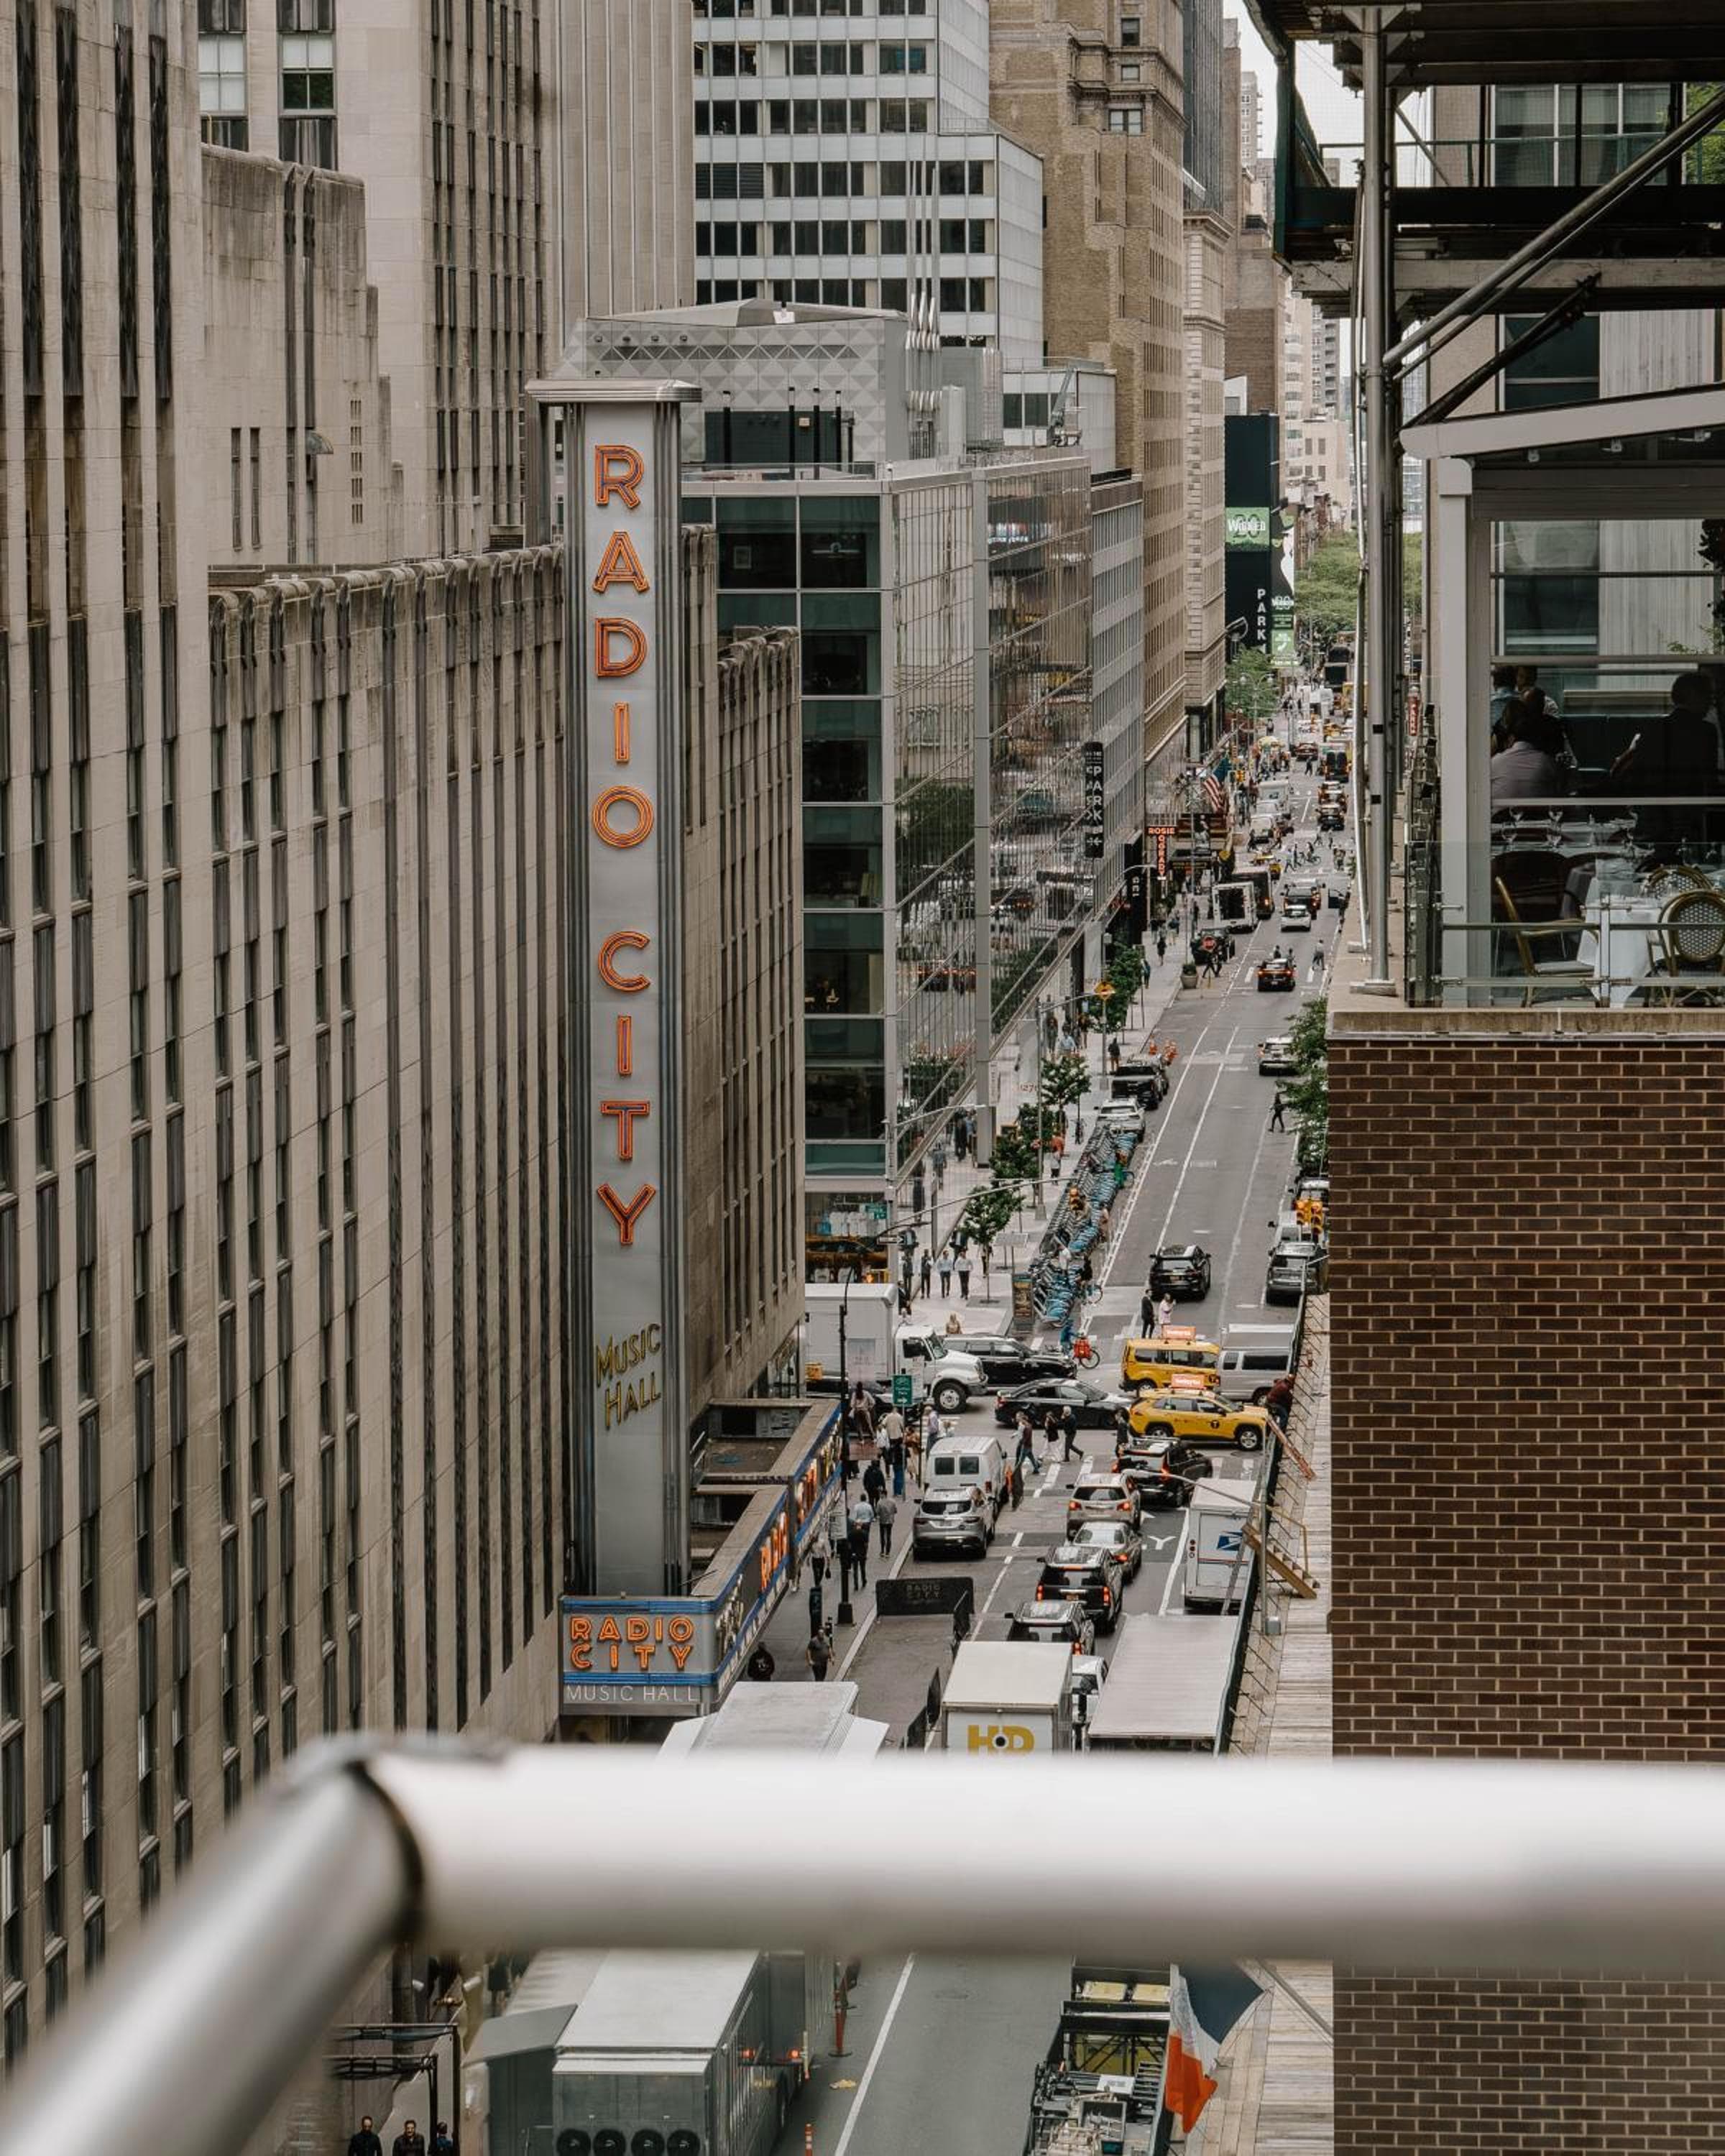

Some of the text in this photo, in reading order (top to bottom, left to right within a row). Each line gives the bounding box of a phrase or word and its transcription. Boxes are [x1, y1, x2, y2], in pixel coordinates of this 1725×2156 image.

[1257, 589, 1266, 640] PARK
[1093, 765, 1102, 820] PARK
[592, 445, 656, 1245] RADIO CITY
[596, 1323, 661, 1388] MUSIC
[605, 1371, 661, 1431] HALL
[571, 1616, 694, 1641] RADIO
[571, 1643, 692, 1670] CITY
[566, 1686, 701, 1702] MUSIC HALL
